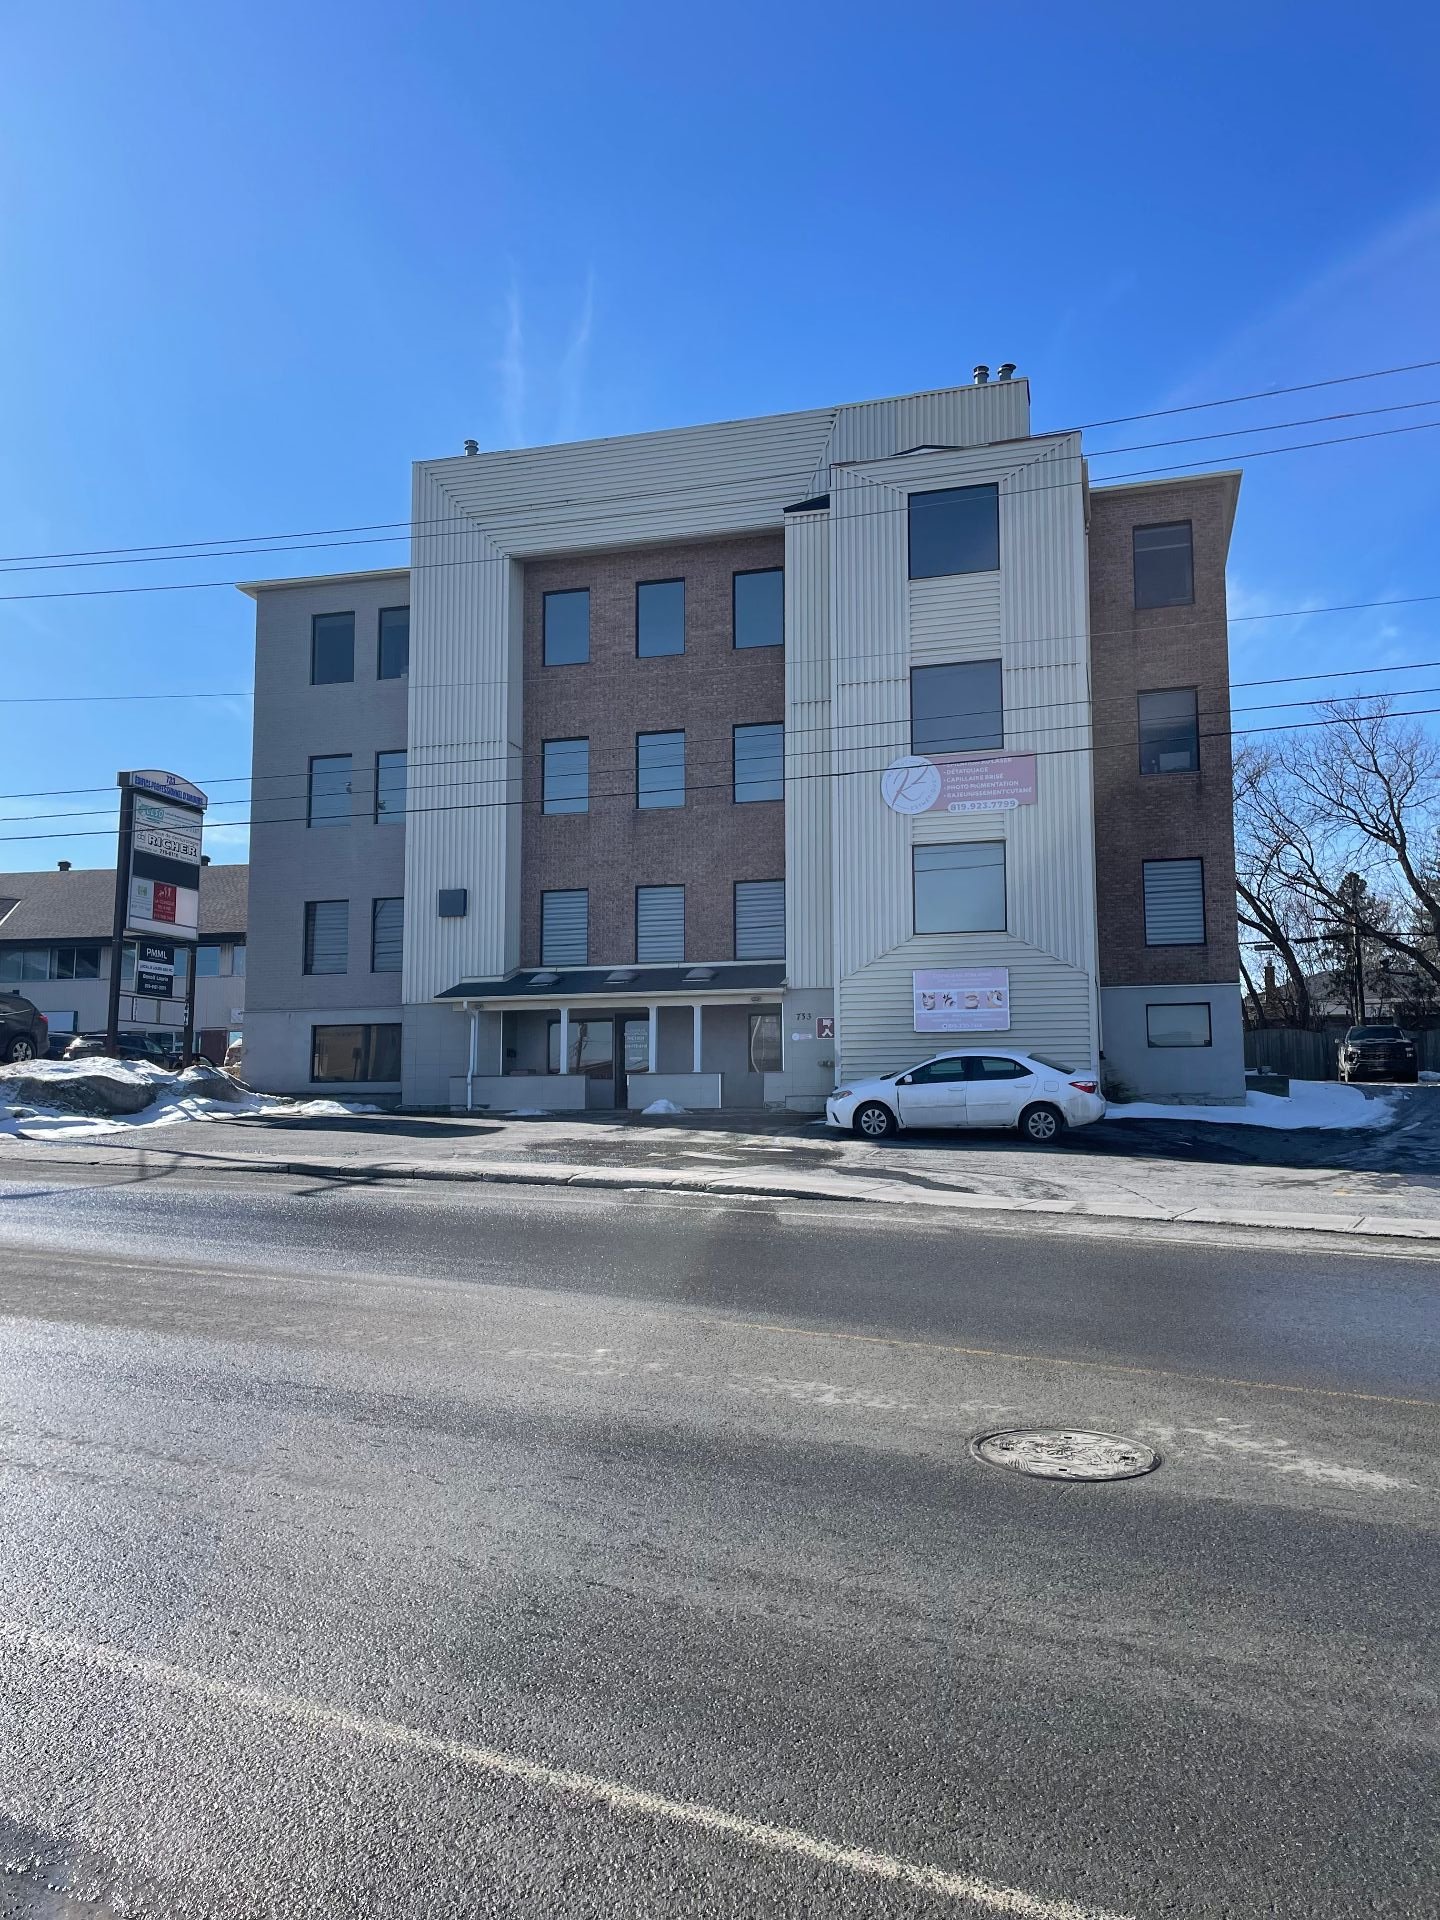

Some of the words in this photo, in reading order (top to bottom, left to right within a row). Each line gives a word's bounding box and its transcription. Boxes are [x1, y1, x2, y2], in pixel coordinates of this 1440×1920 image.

[950, 800, 1016, 812] 819.923.7799
[147, 834, 198, 858] RICHER
[146, 947, 168, 960] PMML
[795, 1012, 812, 1021] 733
